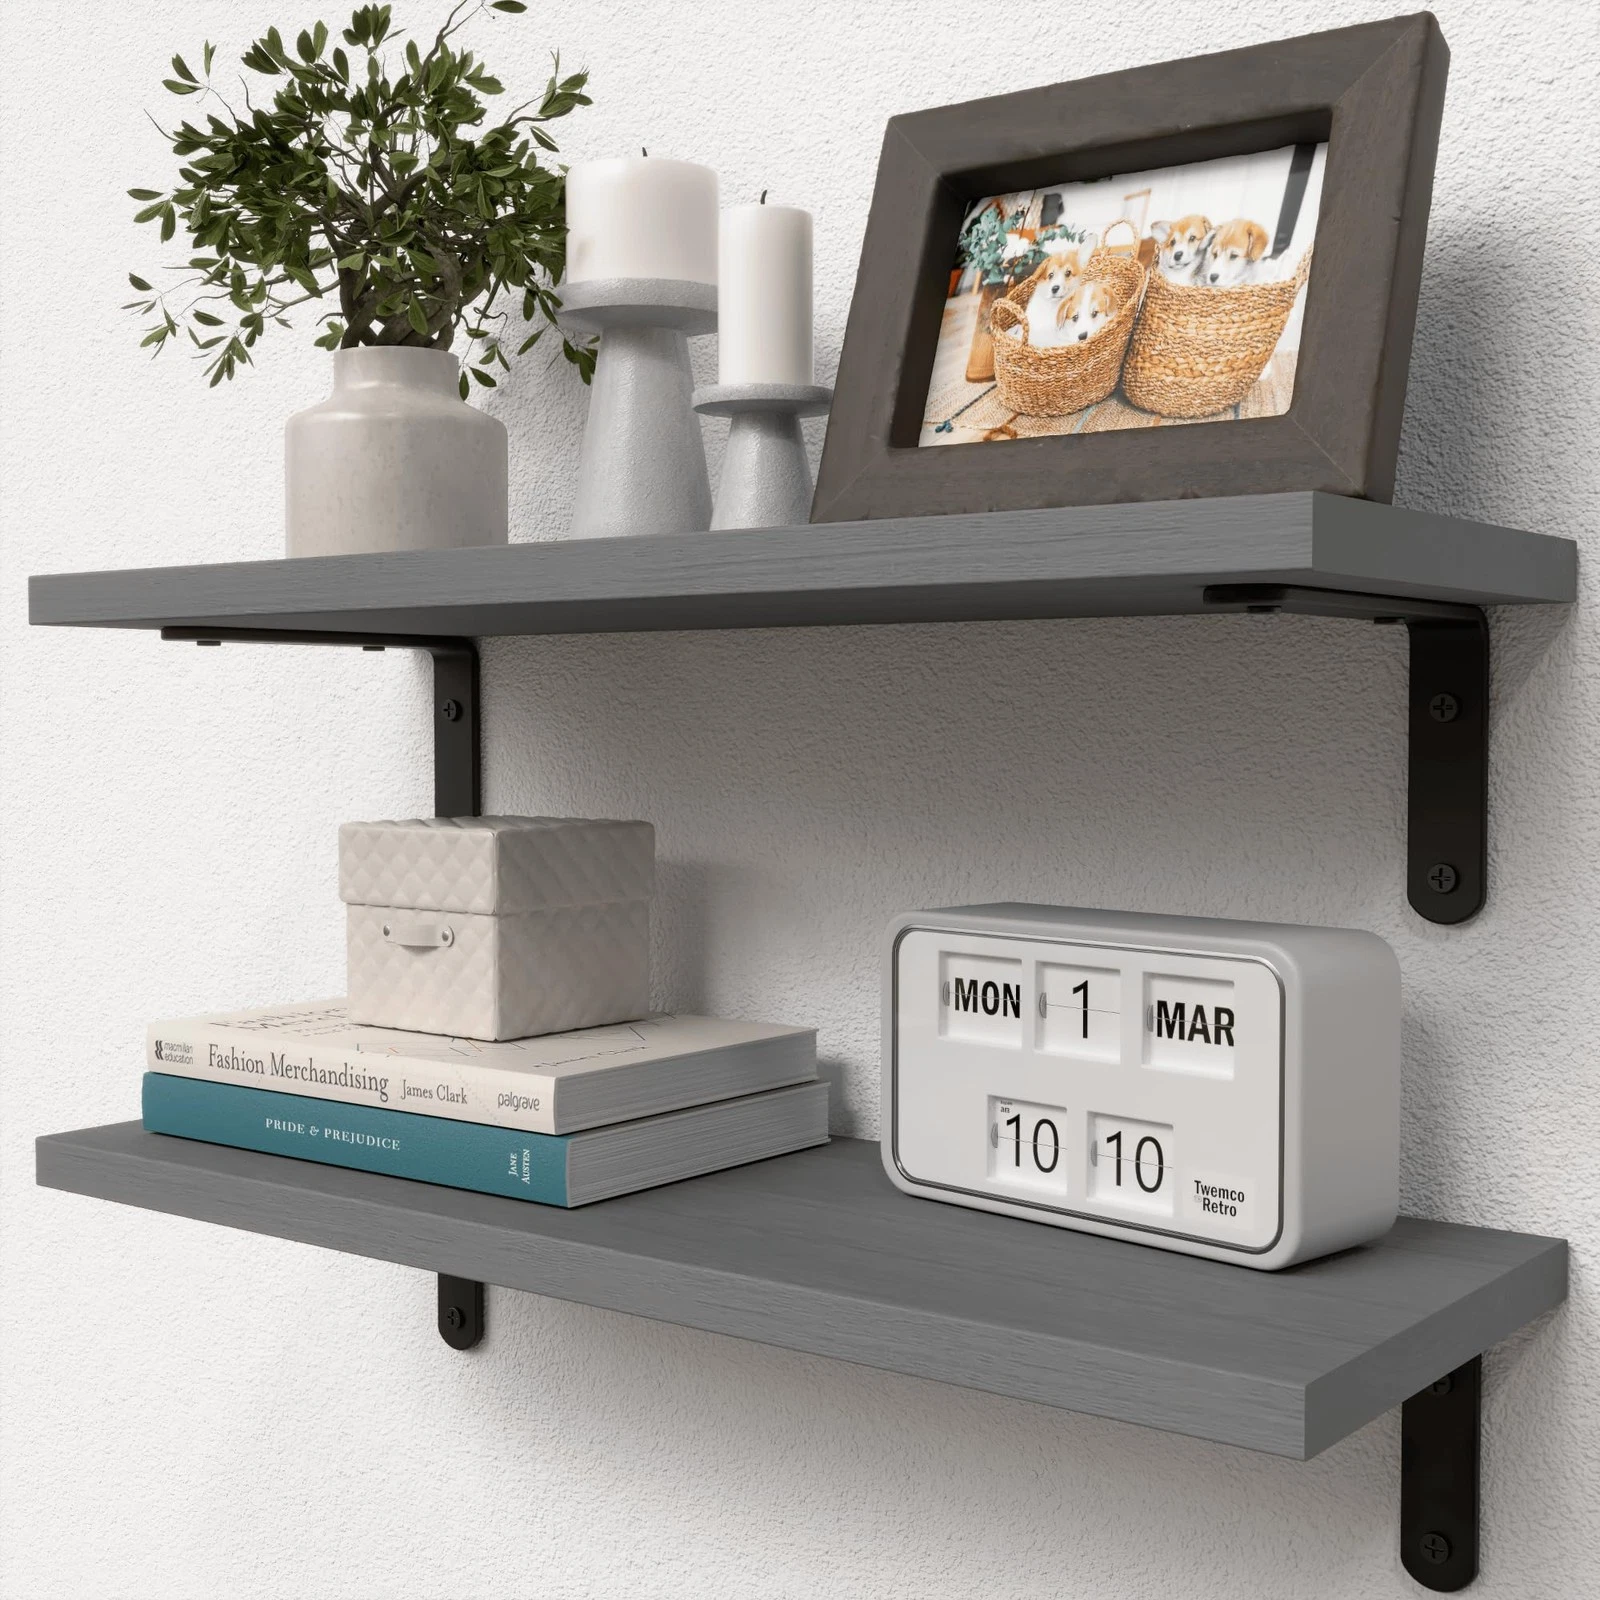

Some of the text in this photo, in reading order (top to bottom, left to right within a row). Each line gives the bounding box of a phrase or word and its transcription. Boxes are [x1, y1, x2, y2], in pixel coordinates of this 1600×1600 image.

[954, 977, 1235, 1047] MON 1 MAR
[164, 1052, 194, 1065] education
[208, 1043, 390, 1103] Fashion Merchandising
[400, 1079, 468, 1105] James Clark
[497, 1091, 540, 1112] palgrave
[265, 1118, 401, 1151] PRIDE & PREJUDICE
[508, 1152, 519, 1177] JANE
[521, 1148, 531, 1185] AUSTEN
[1006, 1113, 1164, 1194] 10 10
[1193, 1179, 1245, 1203] Twemco
[1202, 1196, 1237, 1217] Retro
